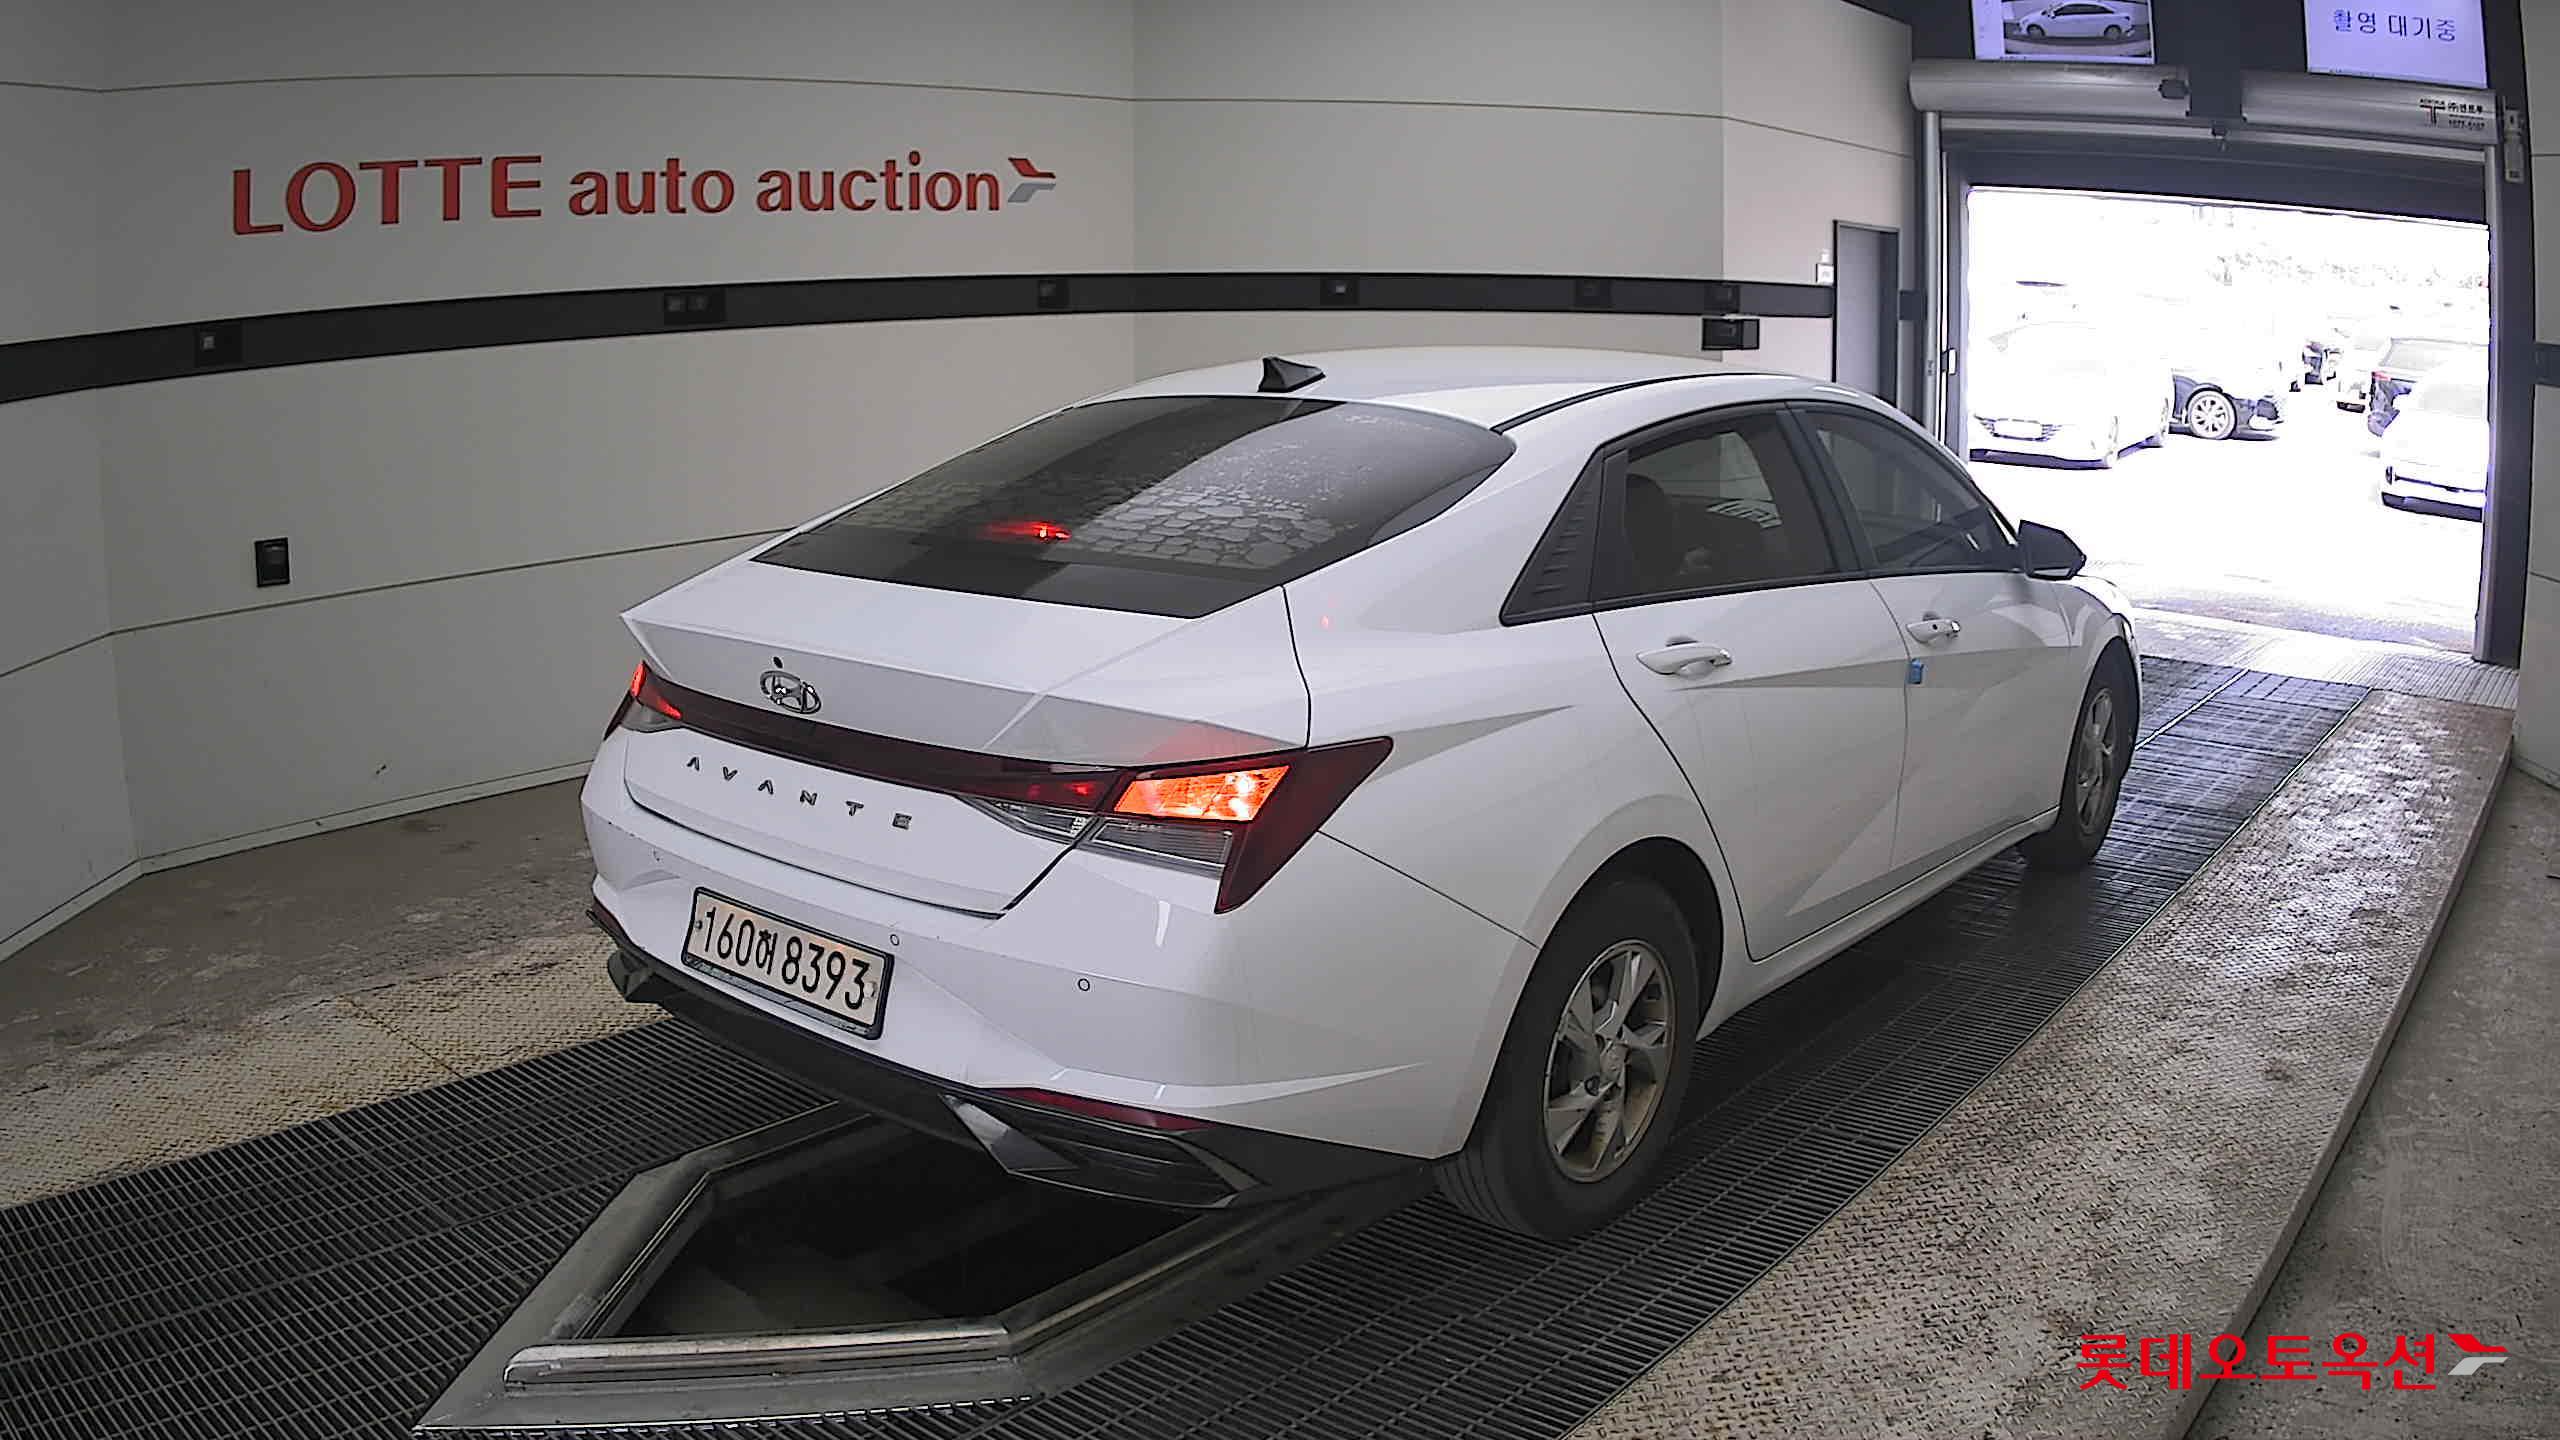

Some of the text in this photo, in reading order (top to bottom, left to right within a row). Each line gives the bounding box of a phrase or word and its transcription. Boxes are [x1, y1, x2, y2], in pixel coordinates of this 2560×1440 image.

[2388, 14, 2456, 42] 대기중
[232, 150, 1000, 236] LOTTE auto auction
[686, 756, 912, 830] AVANTE
[705, 906, 870, 1010] 160허8393
